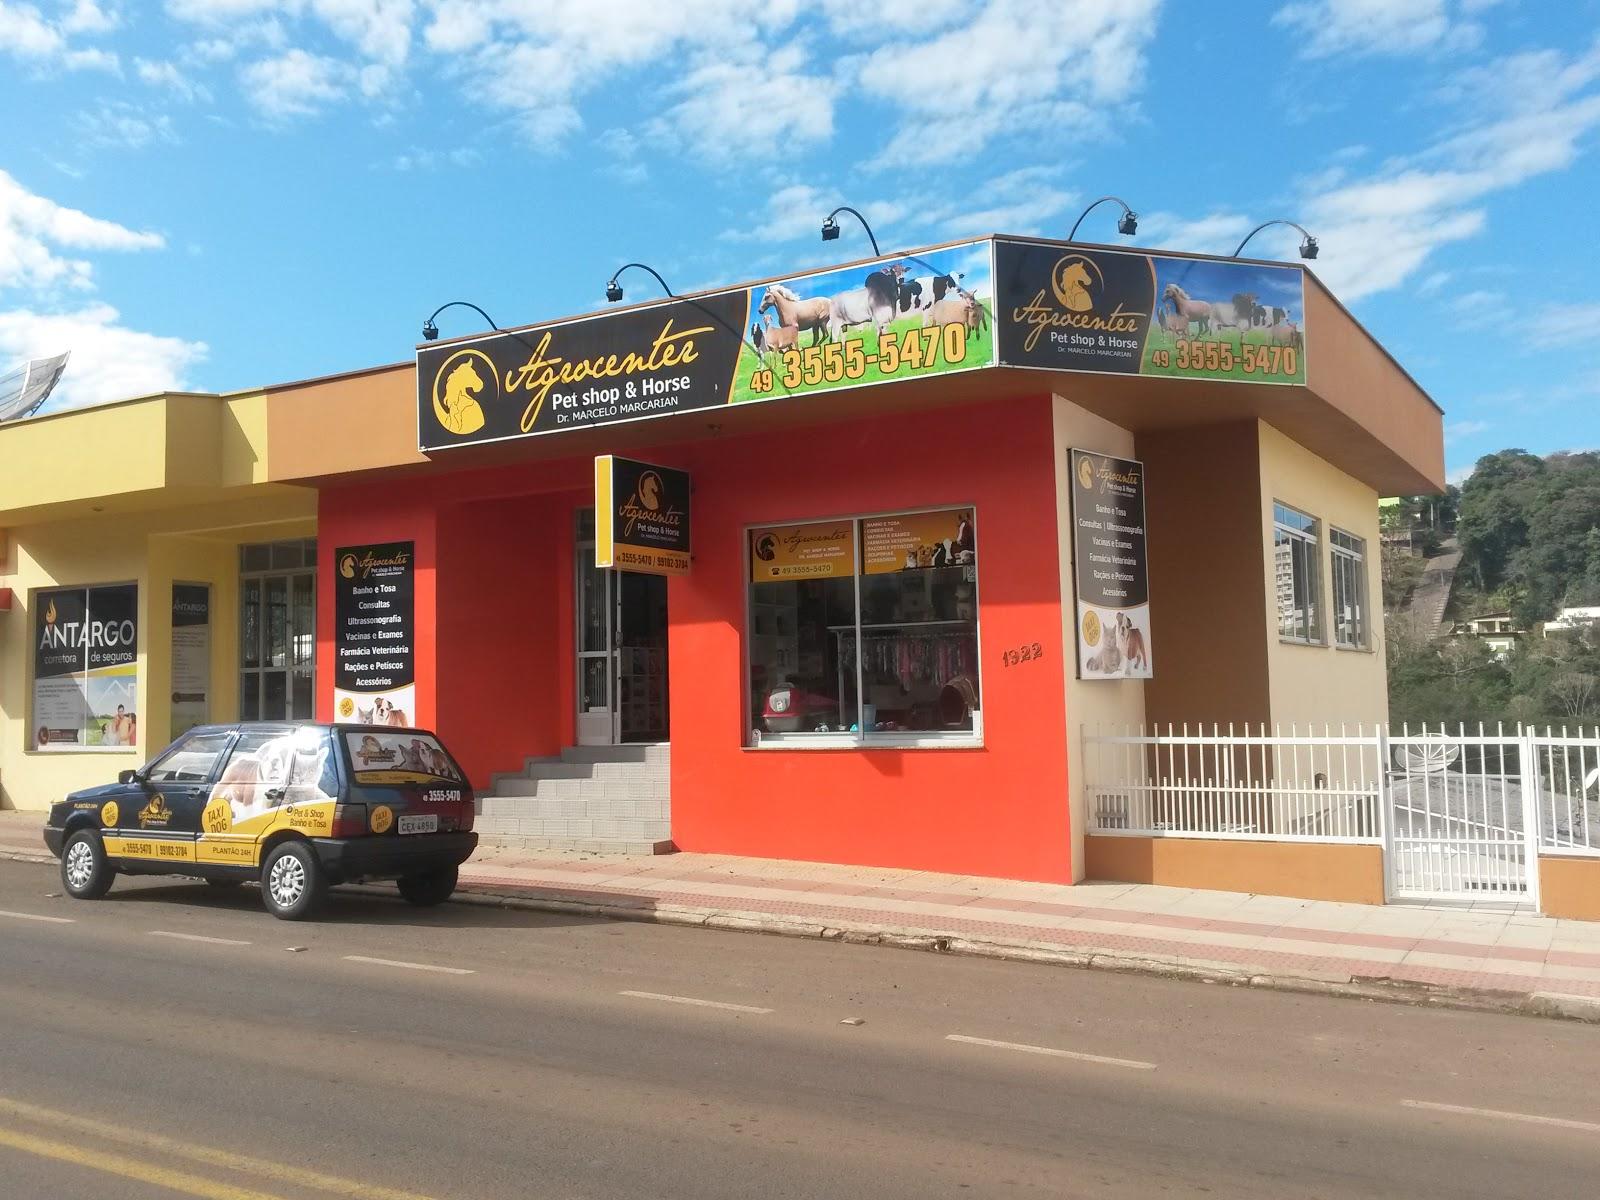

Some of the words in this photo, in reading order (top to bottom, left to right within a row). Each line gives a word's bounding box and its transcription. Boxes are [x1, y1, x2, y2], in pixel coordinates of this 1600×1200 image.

[1013, 289, 1147, 351] Agrocenter
[1050, 331, 1068, 343] Pet
[1070, 333, 1095, 348] shop
[1098, 335, 1106, 346] &
[1108, 336, 1138, 349] Horse
[750, 369, 773, 393] 49
[782, 322, 967, 389] 3555-5470
[1067, 347, 1095, 356] MARCELO
[1096, 349, 1132, 358] MARCARIAN
[1152, 350, 1169, 367] 49
[1175, 338, 1297, 375] 3555-5470
[505, 318, 715, 432] Agrocenter
[552, 391, 578, 410] Pet
[582, 387, 620, 408] shop
[625, 382, 637, 398] &
[642, 375, 691, 396] Horse
[557, 413, 570, 424] Dr.
[572, 405, 618, 421] MARCELO
[619, 396, 679, 415] MARCARIAN
[619, 493, 685, 537] Agrocenter
[1095, 504, 1111, 514] Banho
[1116, 507, 1127, 517] Tosa
[637, 523, 646, 532] Pet
[647, 524, 660, 535] shop
[666, 527, 680, 537] Horse
[1079, 518, 1102, 529] Consultas
[1106, 522, 1143, 535] Ultrassonografia
[783, 528, 849, 552] Agrocenter
[1092, 536, 1111, 547] Vacinas
[1115, 539, 1133, 550] Exames
[622, 552, 652, 565] 3555-5470
[1089, 552, 1111, 564] Farmácia
[1112, 555, 1137, 566] Veterinária
[782, 567, 791, 575] 49
[1093, 569, 1111, 581] Rações
[1115, 572, 1135, 582] Petiscos
[353, 586, 373, 595] Banho
[380, 584, 396, 593] Tosa
[1102, 587, 1128, 597] Acessórios
[358, 600, 390, 610] Consultas
[347, 614, 402, 626] Ultrassonografia
[40, 619, 135, 650] ANTARGO
[346, 632, 371, 640] Vacinas
[378, 631, 403, 639] Exames
[340, 646, 371, 656] Farmácia
[372, 645, 409, 654] Veterinária
[44, 653, 77, 665] corretora
[91, 651, 101, 662] de
[103, 652, 133, 664] seguros
[344, 662, 368, 672] Rações
[375, 661, 403, 670] Petiscos
[356, 677, 391, 686] Acessórios
[428, 790, 461, 802] 3555-5470
[207, 805, 225, 823] TAXI
[294, 808, 304, 818] Pet
[310, 809, 325, 820] Shop
[210, 818, 228, 833] DOG
[290, 818, 307, 827] Banho
[313, 819, 327, 828] Tosa
[212, 846, 240, 856] PLANTÃO
[240, 848, 252, 856] 24H
